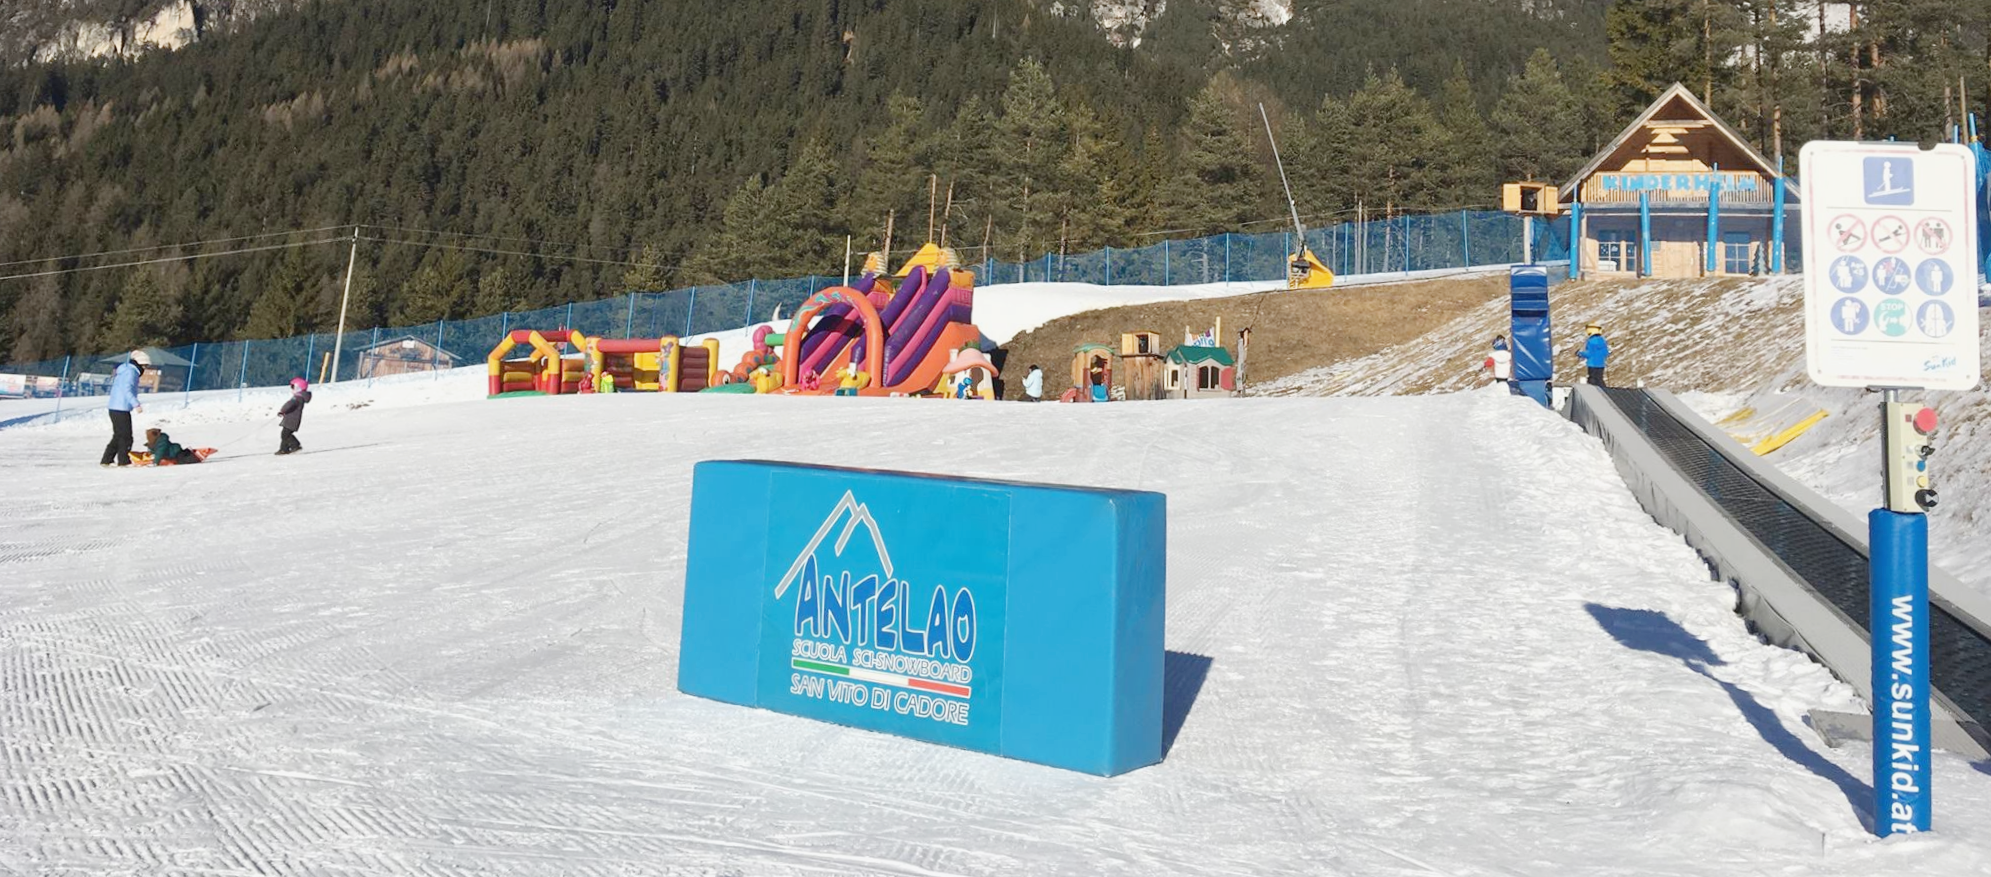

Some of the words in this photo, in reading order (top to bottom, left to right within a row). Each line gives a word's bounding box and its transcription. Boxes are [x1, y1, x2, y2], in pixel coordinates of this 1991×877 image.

[1880, 302, 1904, 311] STOP
[795, 553, 977, 663] ANTELAO
[792, 638, 847, 663] SCUOLA
[853, 649, 972, 683] SCI-SNOWBOARD
[790, 673, 825, 699] SAN
[827, 679, 868, 706] VITO
[871, 687, 891, 711] DI
[894, 693, 969, 726] CADORE
[1891, 595, 1919, 834] www.sunkid.at
